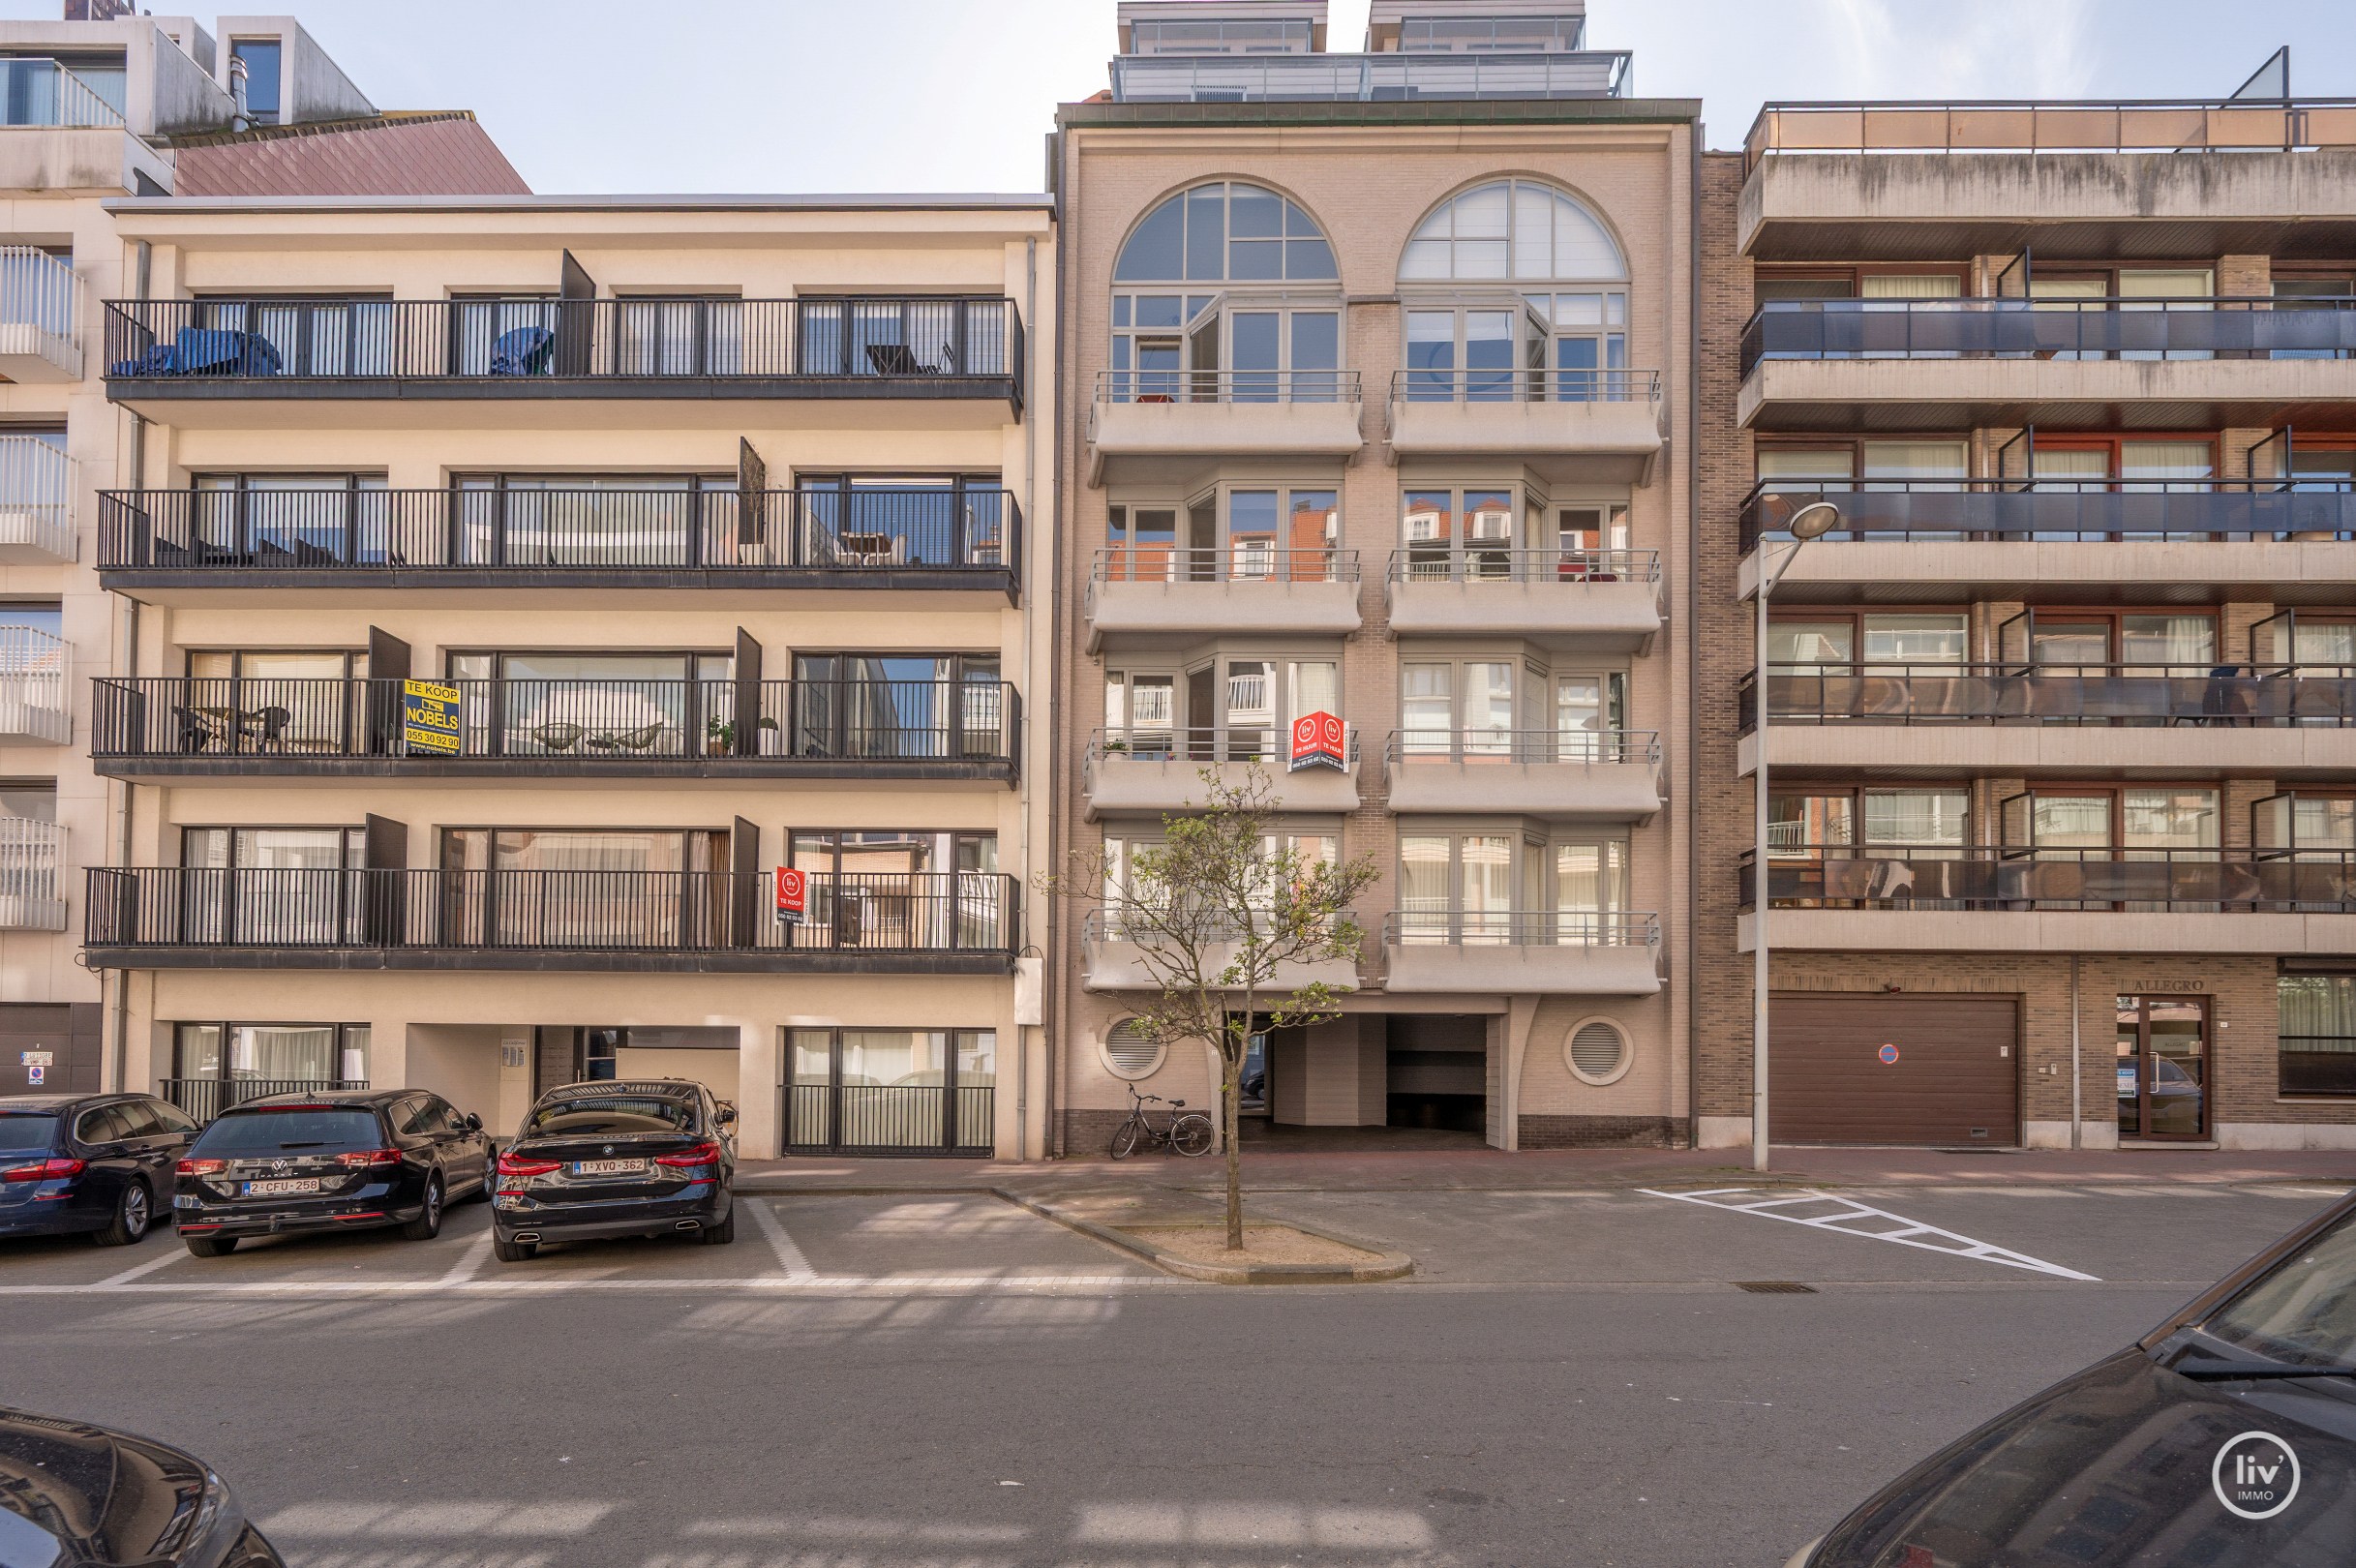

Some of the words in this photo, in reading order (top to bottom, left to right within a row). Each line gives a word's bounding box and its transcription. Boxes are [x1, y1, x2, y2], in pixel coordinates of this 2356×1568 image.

[408, 681, 421, 692] TE
[426, 685, 457, 699] KOOP
[407, 707, 459, 730] NOBELS
[407, 731, 423, 740] 055
[425, 733, 435, 742] 30
[437, 736, 446, 744] 92
[448, 739, 458, 747] 90
[410, 742, 455, 754] www.nobels.be
[1330, 744, 1342, 754] HUUR
[2134, 980, 2204, 992] ALLEGRO
